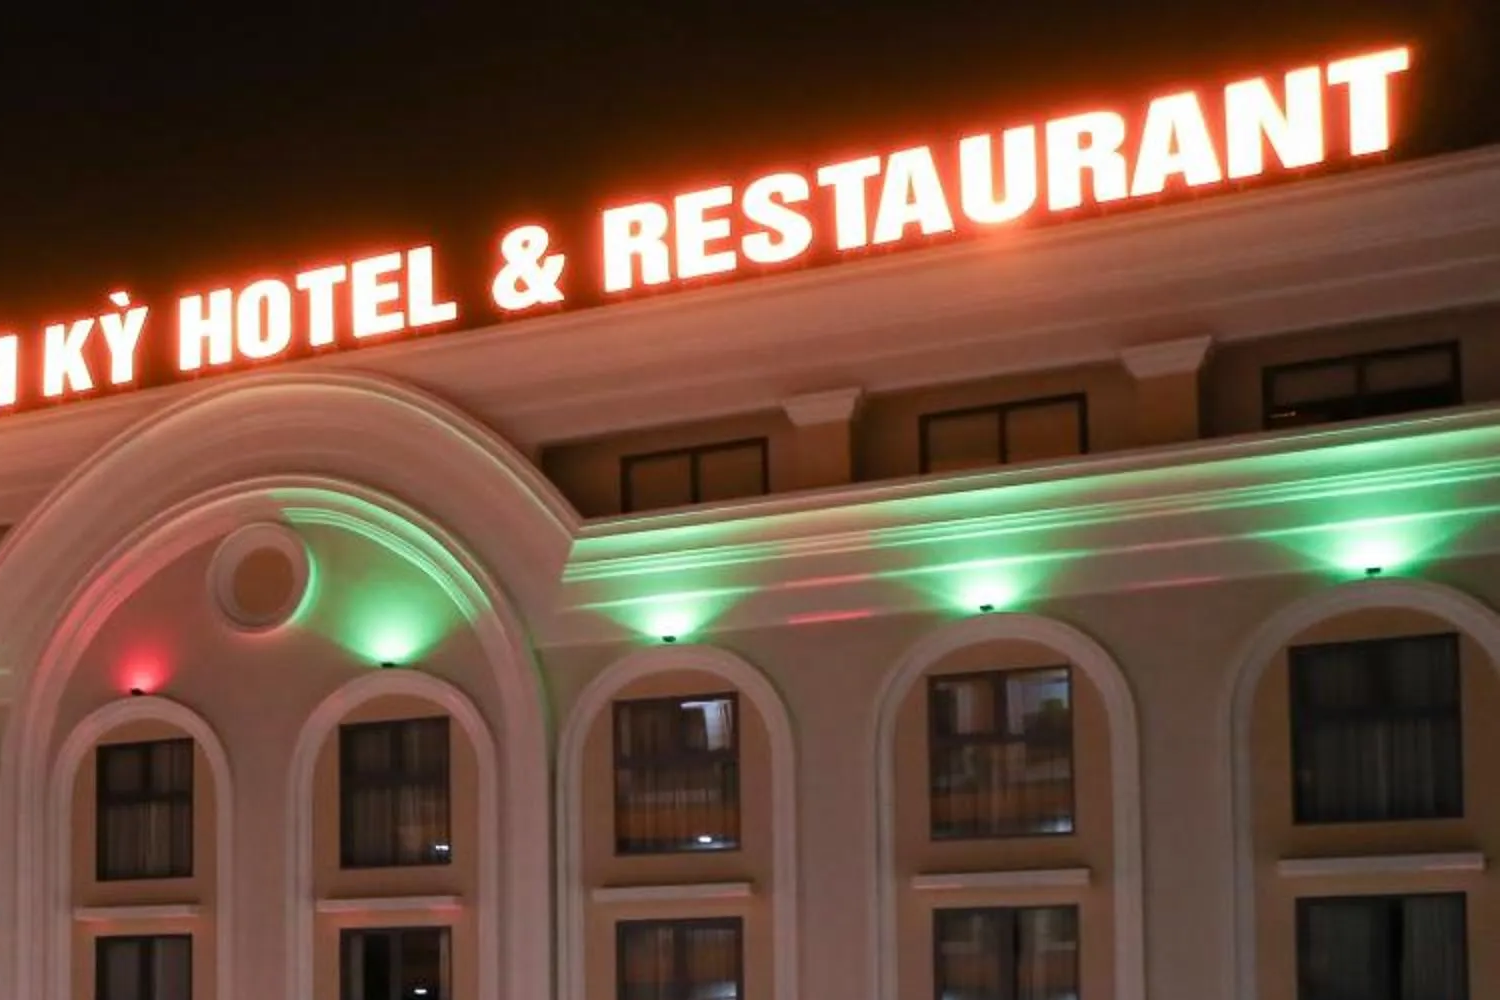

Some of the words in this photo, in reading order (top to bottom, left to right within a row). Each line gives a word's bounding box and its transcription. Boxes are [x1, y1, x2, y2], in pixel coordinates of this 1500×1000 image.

[43, 291, 148, 397] KỲ
[178, 245, 457, 371] HOTEL
[492, 225, 565, 310] &
[602, 48, 1410, 293] RESTAURANT
